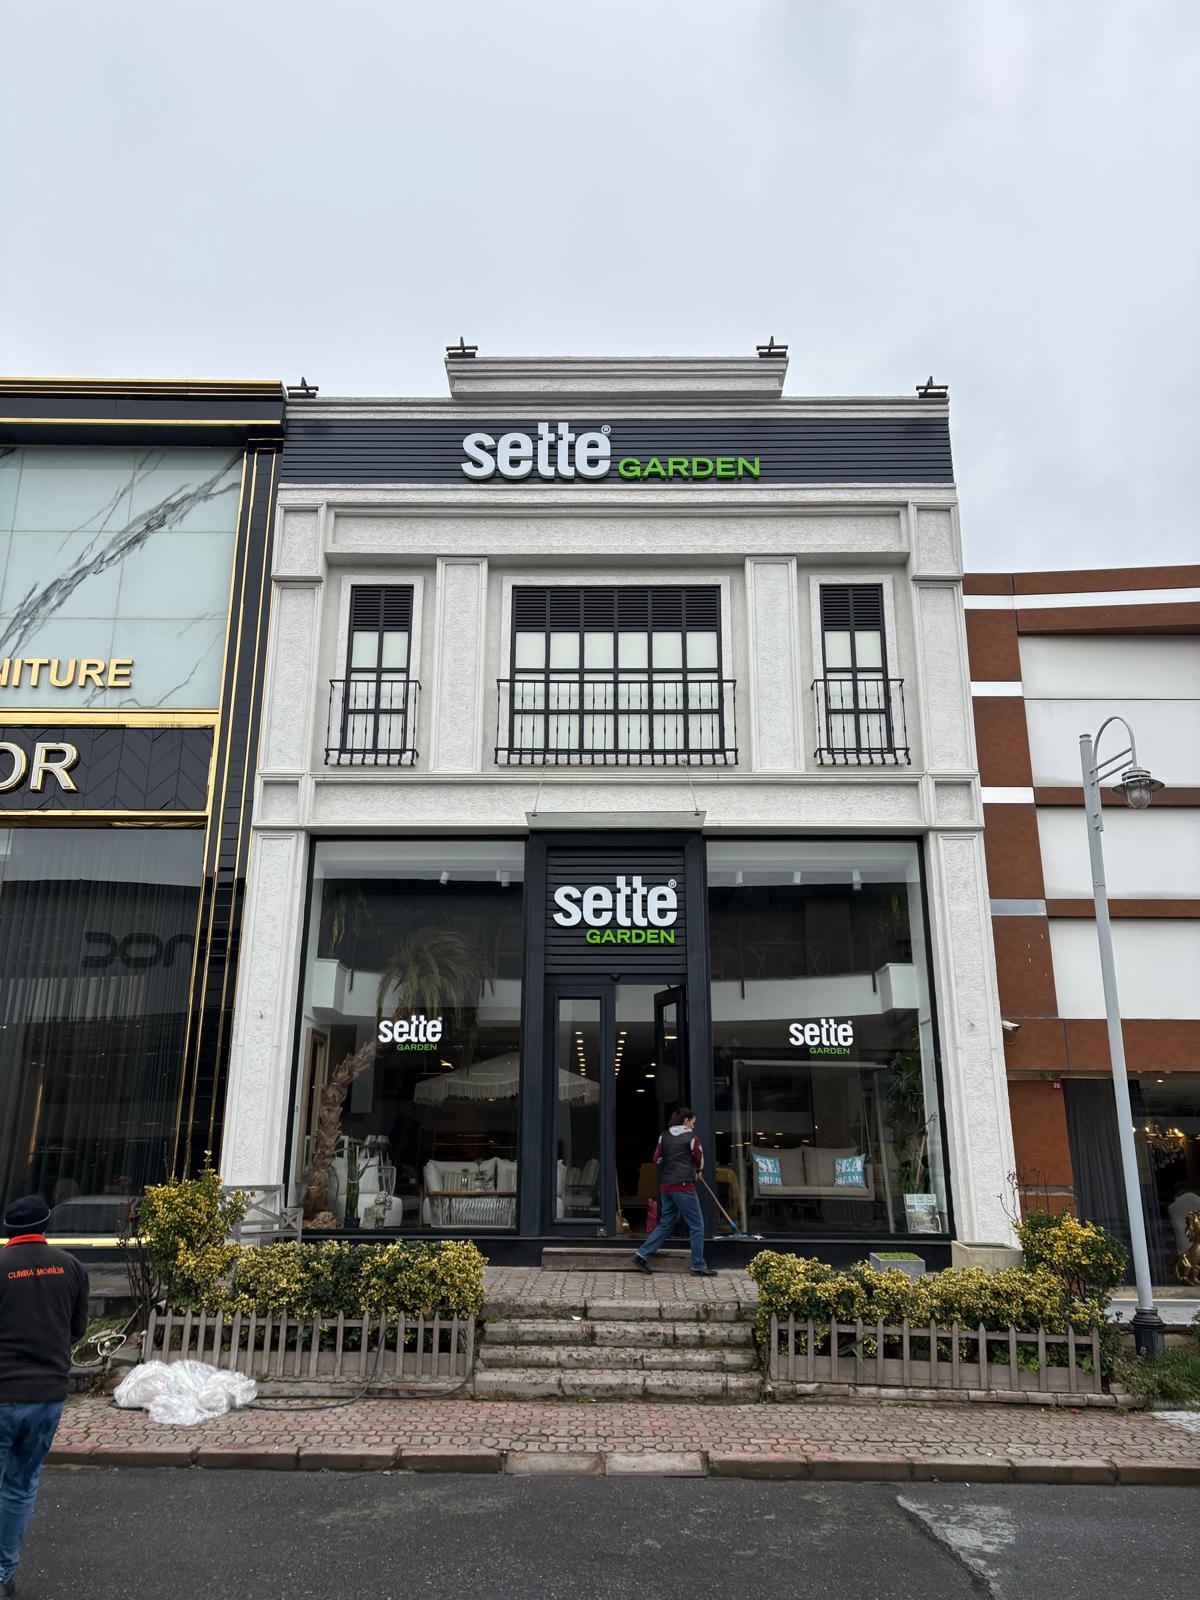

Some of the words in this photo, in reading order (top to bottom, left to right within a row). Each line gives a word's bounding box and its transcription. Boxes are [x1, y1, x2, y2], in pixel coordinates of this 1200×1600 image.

[618, 457, 761, 480] GARDEN
[586, 929, 675, 944] GARDEN
[396, 1043, 438, 1051] GARDEN
[809, 1047, 850, 1055] GARDEN
